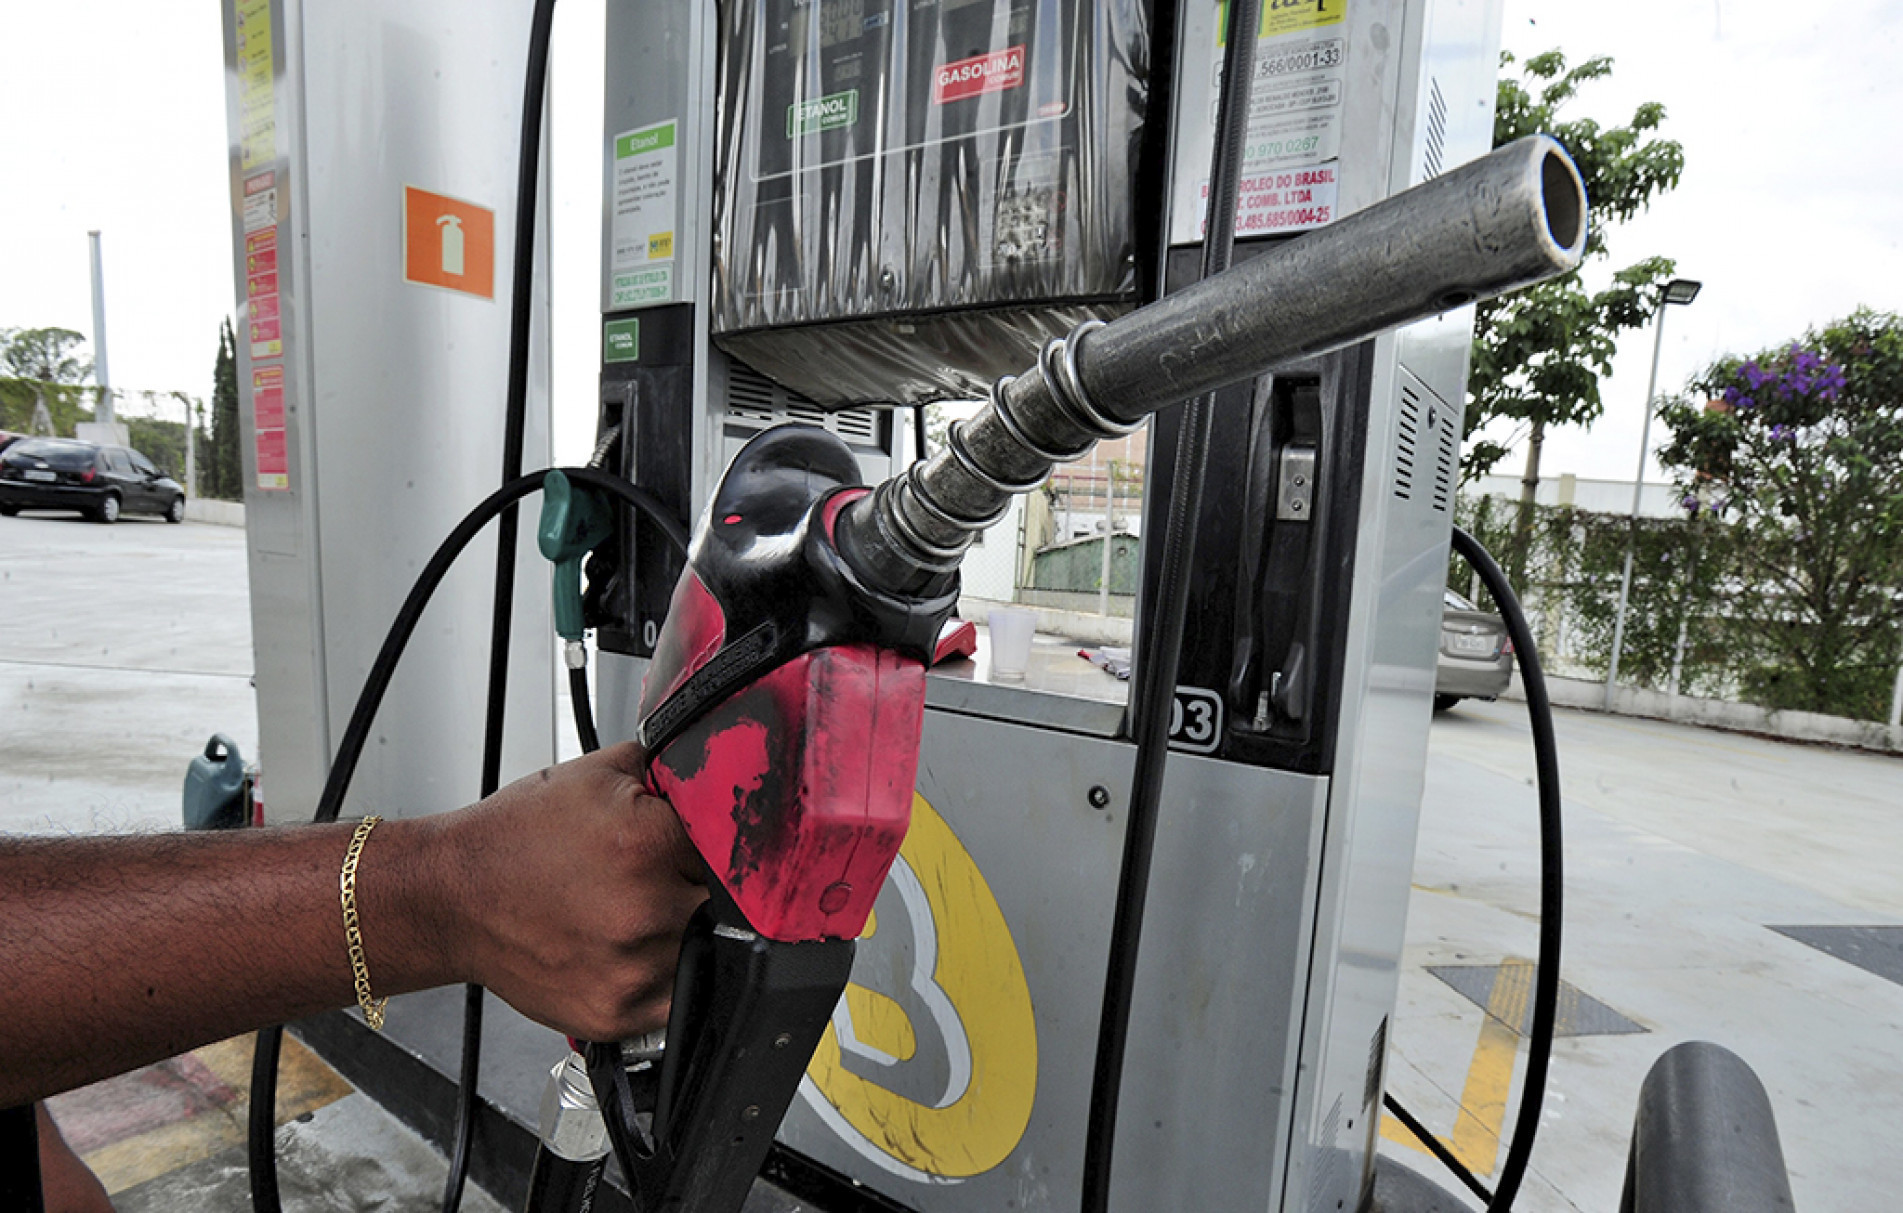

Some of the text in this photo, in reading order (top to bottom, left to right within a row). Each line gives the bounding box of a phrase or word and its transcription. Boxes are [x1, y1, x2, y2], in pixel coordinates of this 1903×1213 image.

[938, 54, 1021, 87] GASOLINA
[1258, 48, 1340, 76] .566/0001-33
[798, 98, 847, 121] ETANOL
[630, 131, 659, 151] Etanol
[1257, 141, 1283, 157] 970
[1285, 136, 1319, 153] 0267
[1240, 176, 1274, 193] ROLEO
[1276, 174, 1292, 189] DO
[1295, 169, 1335, 187] BRASIL
[1284, 188, 1313, 205] LTDA
[644, 620, 657, 649] 0
